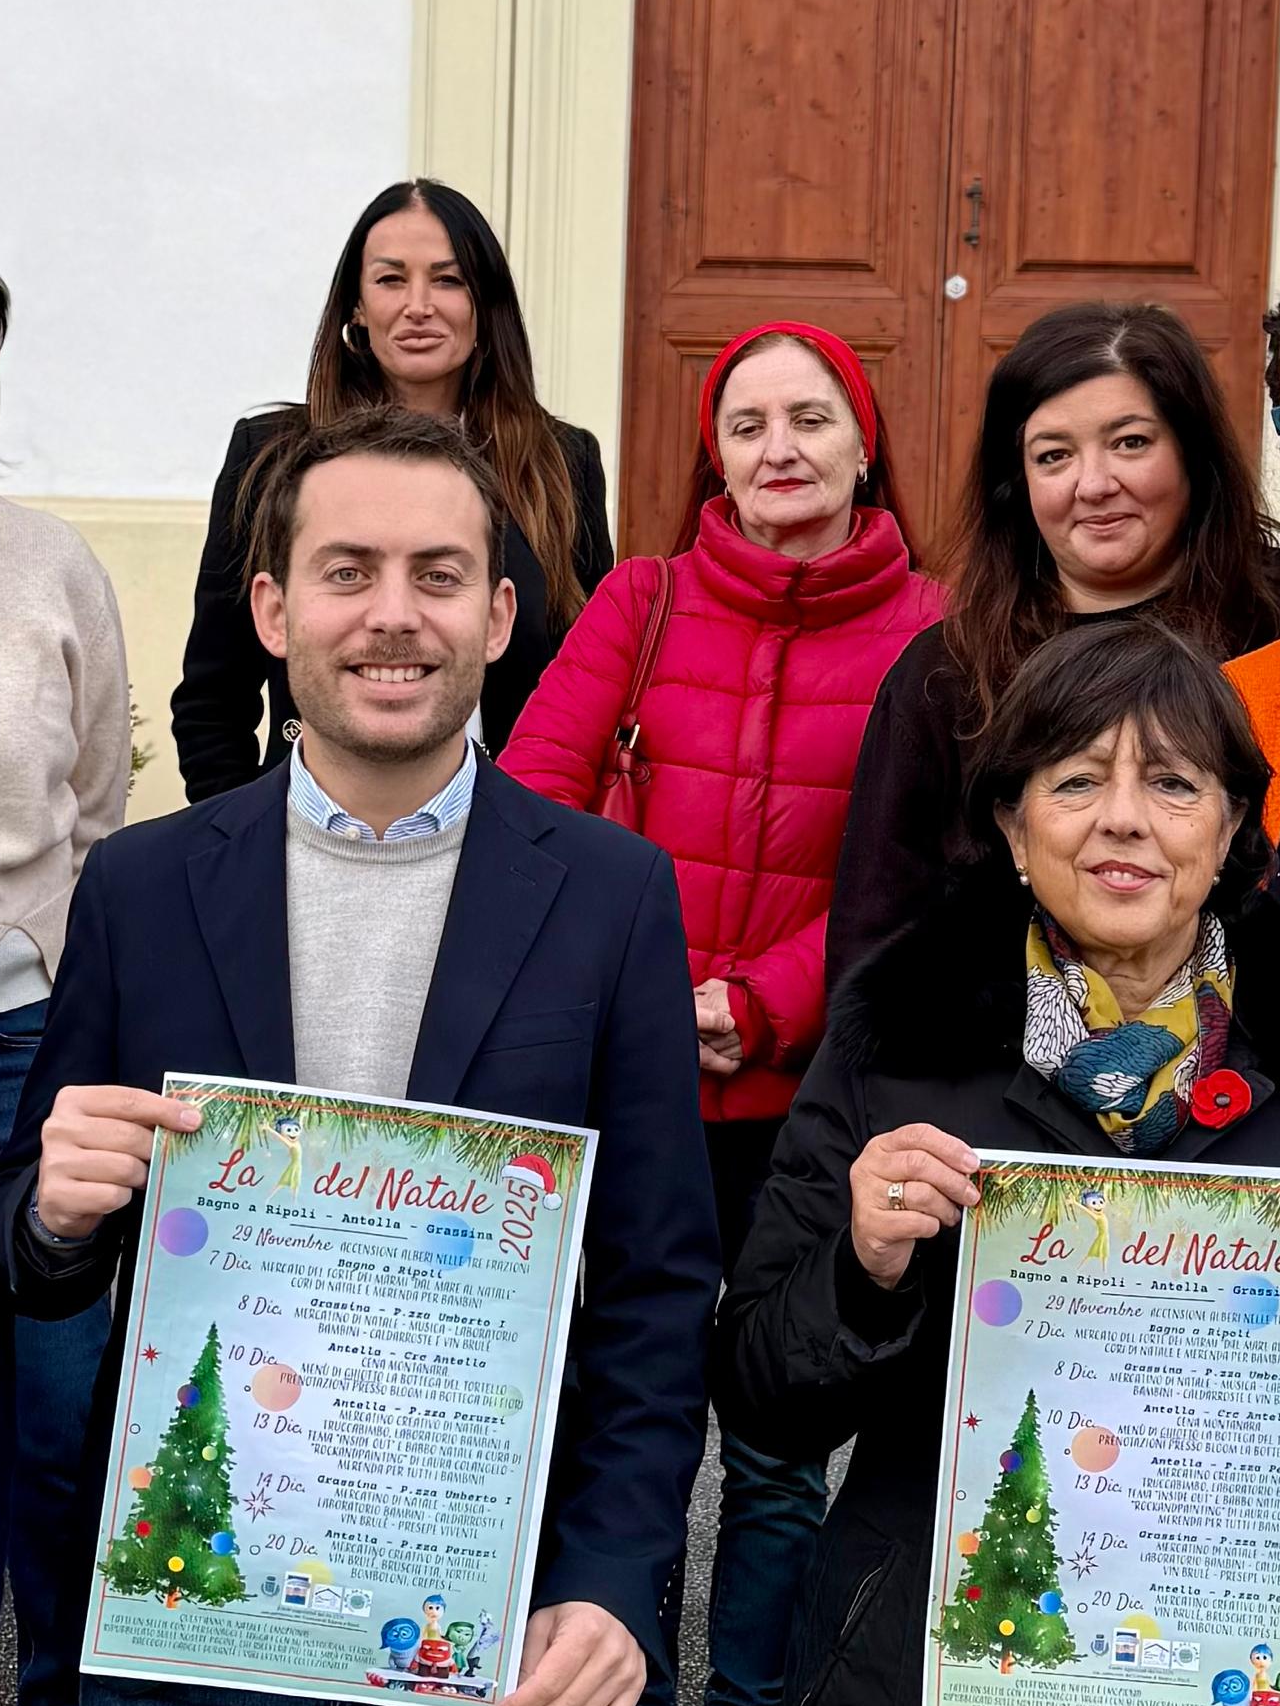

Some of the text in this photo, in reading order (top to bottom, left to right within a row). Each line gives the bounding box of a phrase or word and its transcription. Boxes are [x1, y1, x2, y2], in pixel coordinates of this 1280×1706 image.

[208, 1147, 494, 1213] La del Natale
[197, 1196, 493, 1241] Bagno a Ripoli Antella Grassina
[499, 1179, 541, 1261] 2025
[232, 1224, 253, 1242] 29
[255, 1227, 334, 1251] Novembre
[1020, 1222, 1074, 1266] La
[1122, 1232, 1175, 1265] del
[209, 1250, 252, 1271] 7 Dic.
[337, 1258, 376, 1271] Bagno
[398, 1266, 442, 1279] Ripoli
[1010, 1269, 1052, 1283] Bagno
[1060, 1275, 1068, 1283] a
[1076, 1275, 1125, 1288] Ripoli
[1150, 1280, 1208, 1293] Antella
[238, 1294, 282, 1316] 8 Dic.
[310, 1298, 371, 1313] Grassina
[438, 1313, 491, 1327] Umberto
[1045, 1294, 1065, 1311] 29
[1068, 1297, 1143, 1318] Novembre
[1024, 1319, 1065, 1339] 7 Dic.
[1149, 1324, 1186, 1335] Bagno
[1207, 1327, 1250, 1339] Ripoli
[228, 1344, 279, 1366] 10 Dic.
[328, 1342, 487, 1368] Antella Crc Antella
[1054, 1360, 1097, 1381] 8 Dic.
[1124, 1363, 1183, 1375] Grassina
[332, 1398, 386, 1412] Antella
[453, 1411, 505, 1425] Peruzzi
[1047, 1409, 1096, 1430] 10 Dic.
[1143, 1404, 1195, 1416] Antella
[1217, 1409, 1240, 1419] Crc
[253, 1412, 302, 1435] 13 Dic.
[1150, 1456, 1202, 1468] Antella
[256, 1472, 306, 1493] 14 Dic.
[317, 1475, 378, 1490] Grassina
[445, 1490, 497, 1504] Umberto
[1075, 1474, 1122, 1494] 13 Dic.
[264, 1534, 318, 1556] 20 Dic.
[324, 1529, 378, 1545] Antella
[445, 1545, 497, 1559] Peruzzi
[1081, 1531, 1128, 1551] 14 Dic.
[1139, 1530, 1198, 1542] Grassina
[1149, 1583, 1201, 1596] Antella
[1091, 1590, 1144, 1612] 20 Dic.
